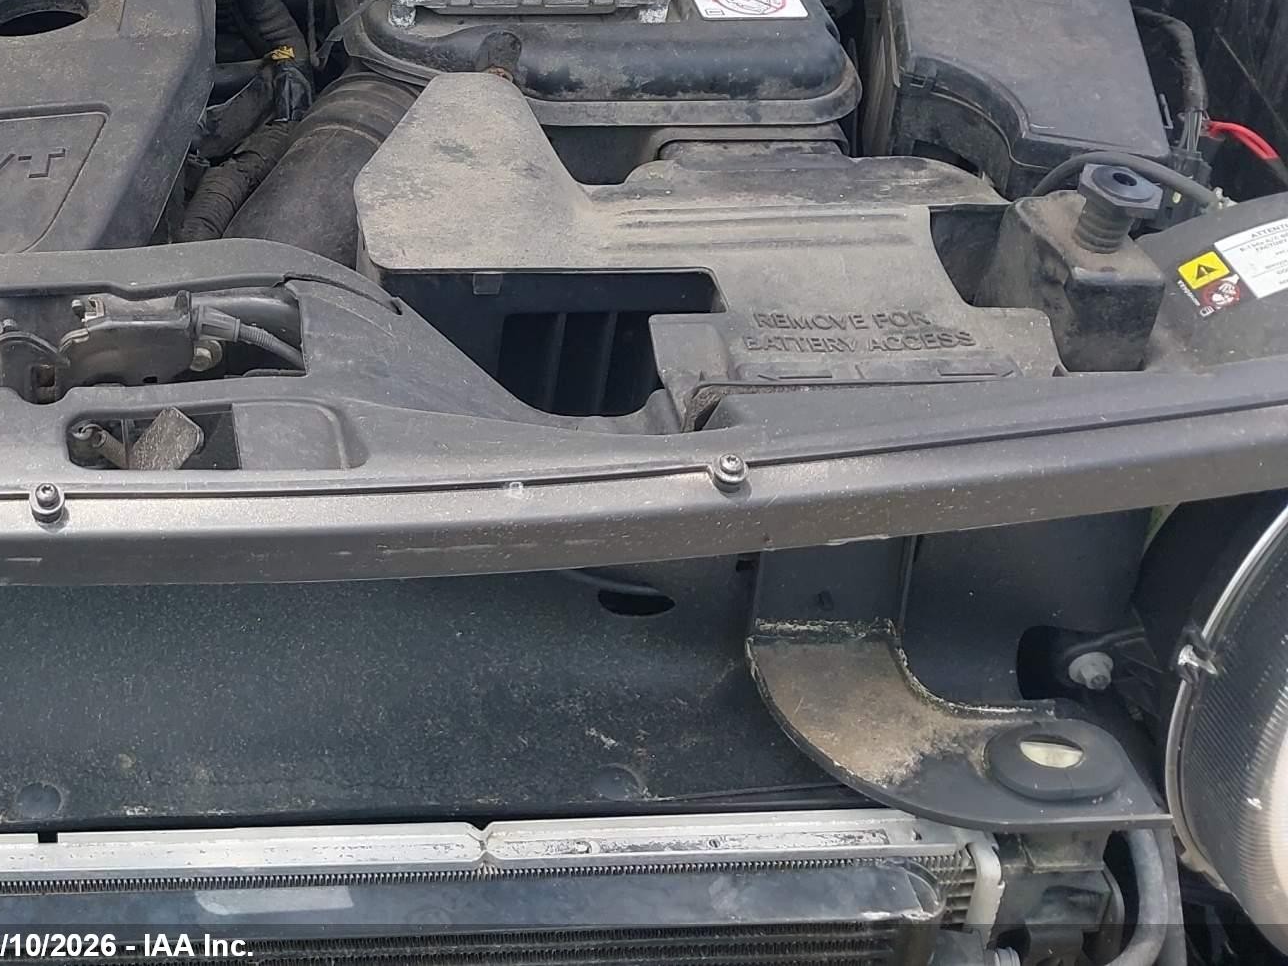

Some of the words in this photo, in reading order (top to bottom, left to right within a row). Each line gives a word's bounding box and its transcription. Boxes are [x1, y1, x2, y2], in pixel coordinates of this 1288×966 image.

[753, 312, 869, 331] REMOVE
[873, 309, 932, 329] FOR
[743, 333, 858, 353] BATTERY
[866, 330, 977, 352] ACCESS
